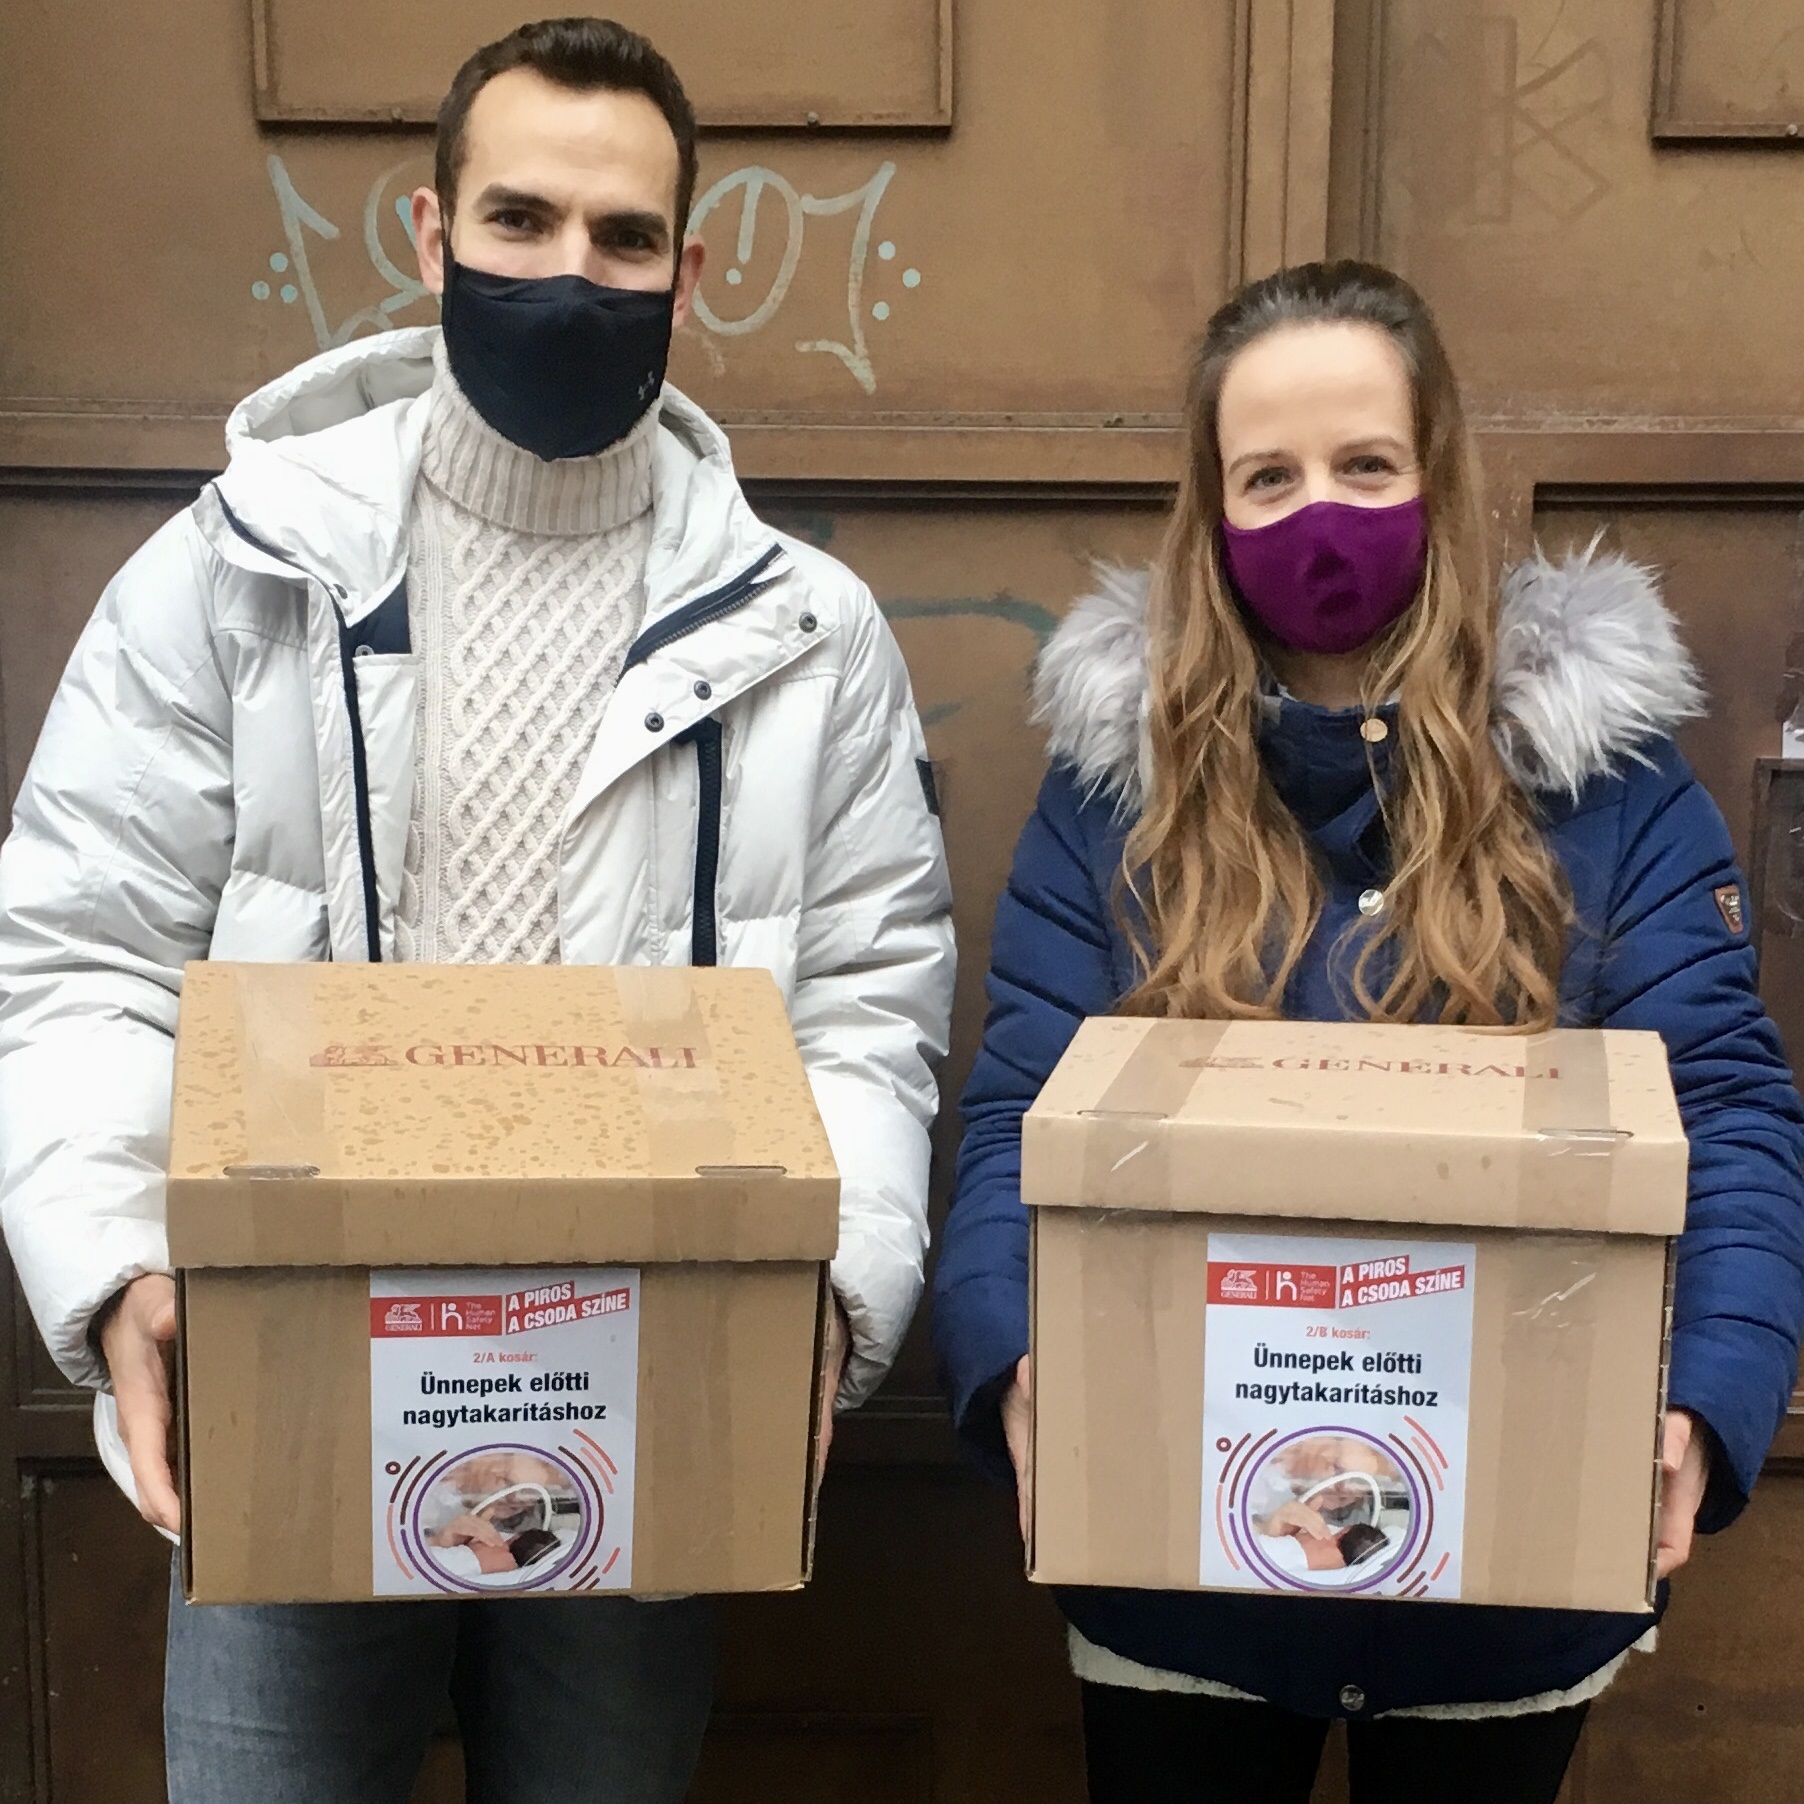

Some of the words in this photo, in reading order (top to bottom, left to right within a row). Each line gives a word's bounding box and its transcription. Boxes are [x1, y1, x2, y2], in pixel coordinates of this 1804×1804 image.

[405, 1044, 697, 1068] GENERALI
[1272, 1058, 1559, 1079] GENERALI
[1342, 1266, 1354, 1285] A
[1358, 1257, 1407, 1283] PIROS
[508, 1294, 521, 1312] A
[524, 1283, 572, 1308] PIROS
[1342, 1289, 1354, 1307] A
[1357, 1279, 1411, 1304] CSODA
[1414, 1270, 1462, 1295] SZÍNE
[508, 1315, 521, 1333] A
[524, 1304, 577, 1330] CSODA
[581, 1291, 628, 1318] SZÍNE
[1306, 1325, 1327, 1338] 2/B
[473, 1352, 495, 1363] 2/A
[1254, 1342, 1354, 1374] Ünnepek
[1362, 1350, 1422, 1374] előtti
[421, 1371, 522, 1397] Ünnepek
[530, 1371, 589, 1392] előtti
[1235, 1380, 1438, 1407] nagytakarításhoz
[403, 1401, 606, 1428] nagytakarításhoz
